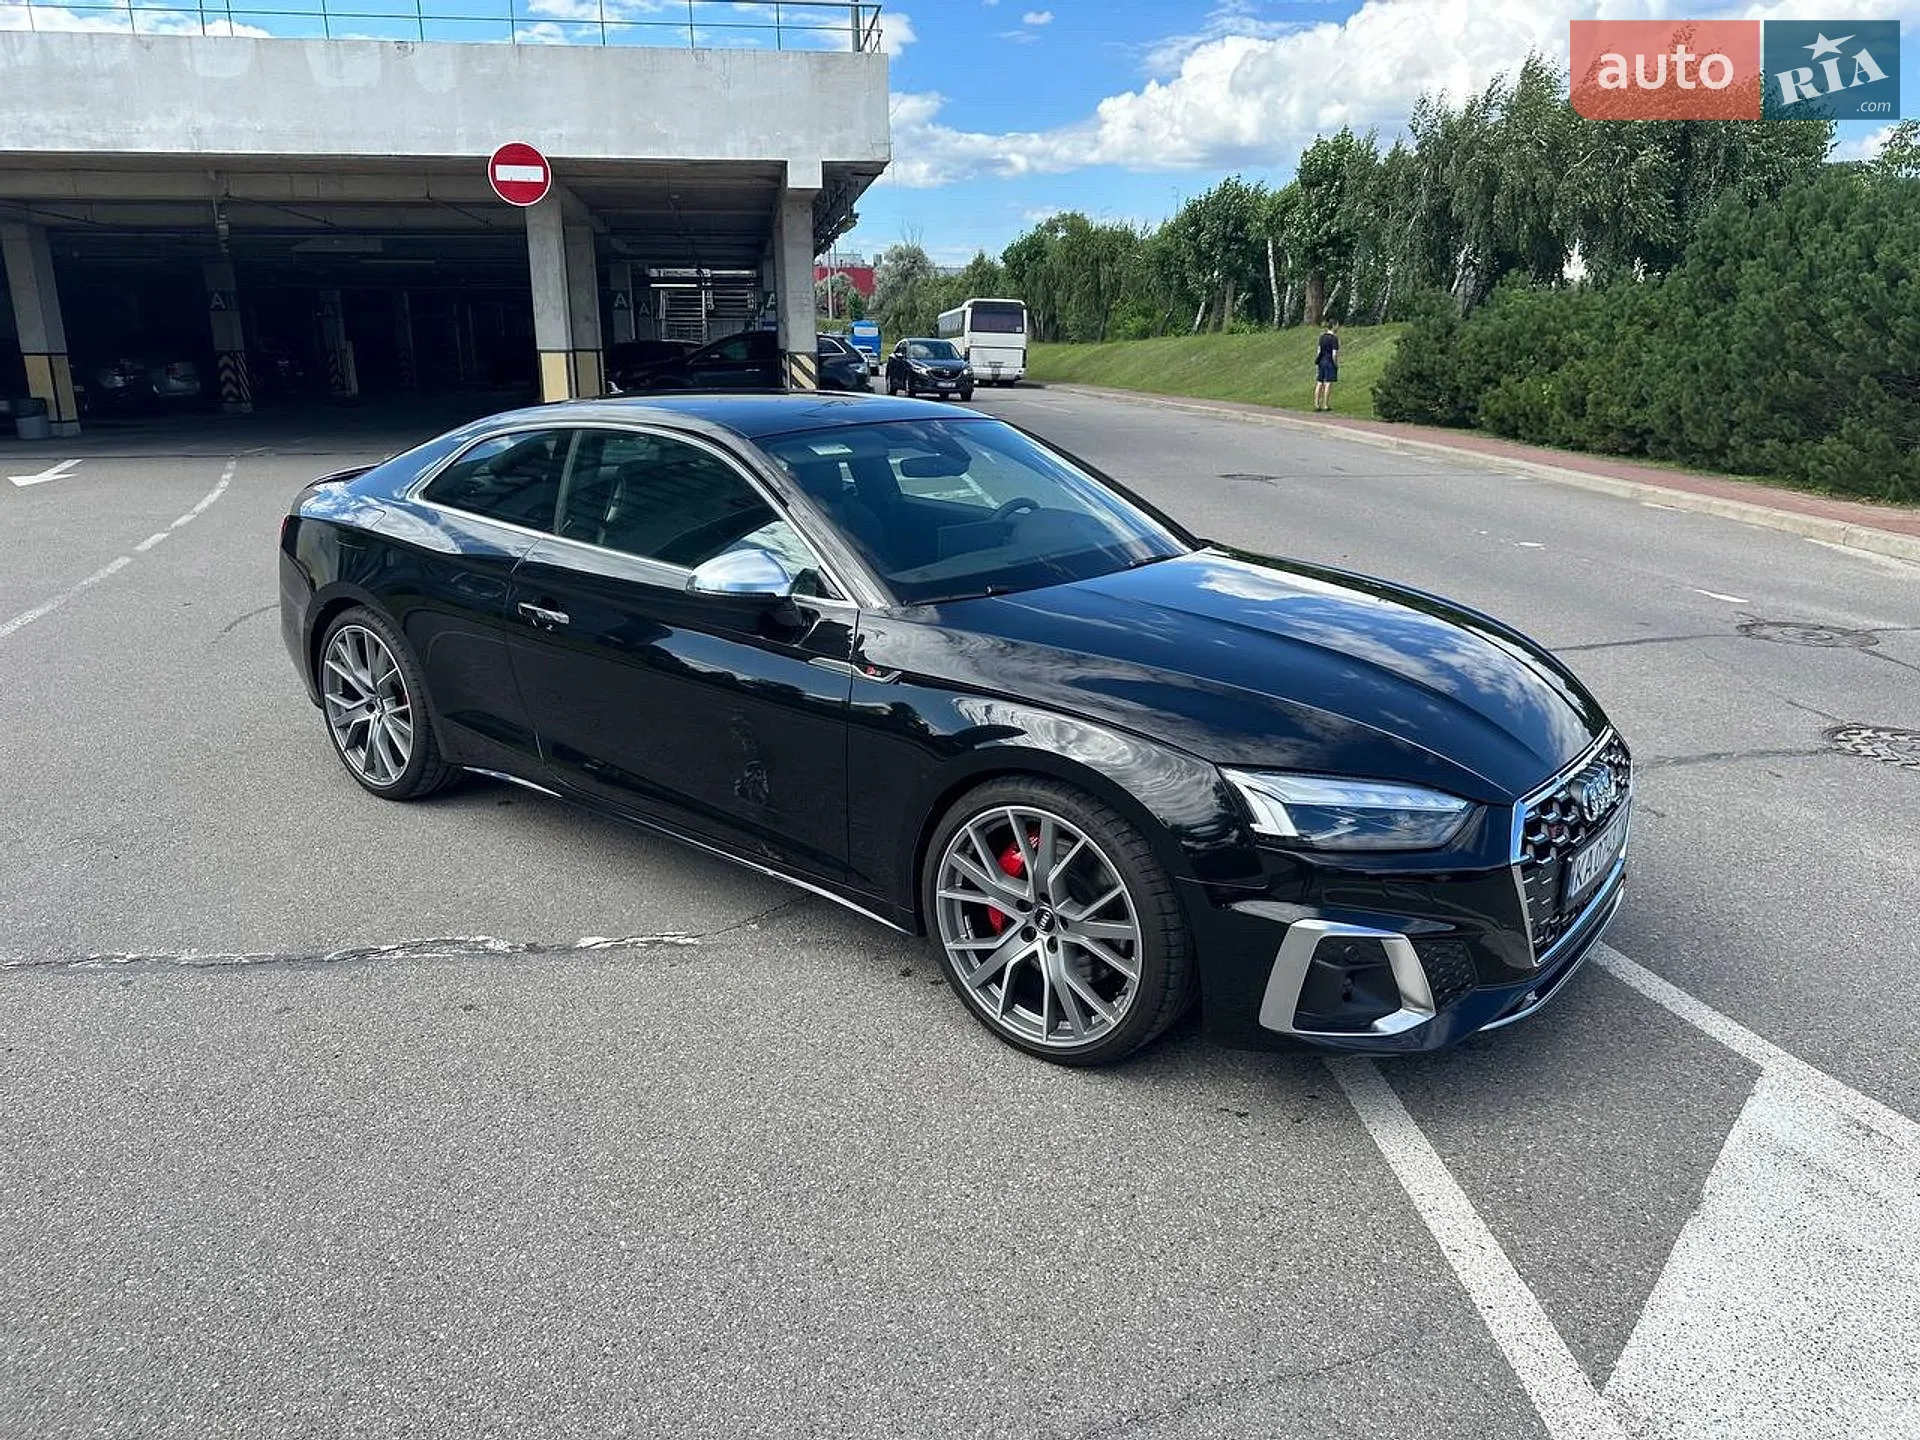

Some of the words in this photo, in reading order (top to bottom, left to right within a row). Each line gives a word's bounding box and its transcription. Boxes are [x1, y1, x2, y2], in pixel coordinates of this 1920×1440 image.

[209, 292, 226, 309] A
[614, 292, 628, 308] A
[639, 302, 650, 316] A
